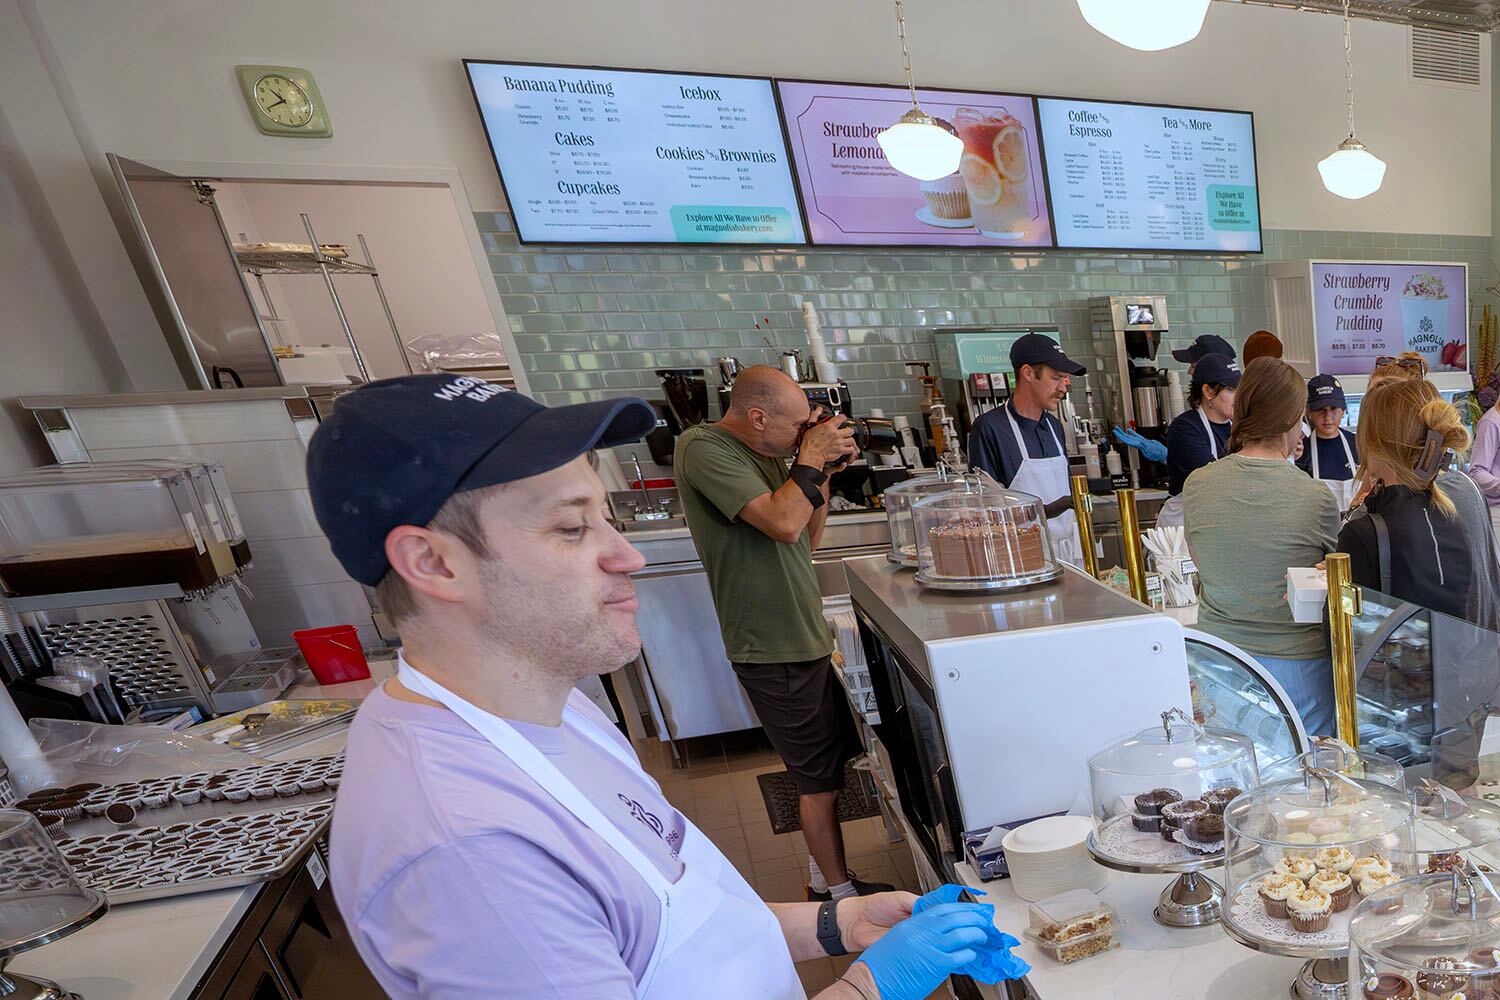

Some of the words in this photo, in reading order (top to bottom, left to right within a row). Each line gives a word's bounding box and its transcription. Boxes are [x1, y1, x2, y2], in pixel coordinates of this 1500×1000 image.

[503, 76, 558, 93] Banana
[558, 79, 615, 98] Pudding
[680, 85, 722, 101] Icebox
[1068, 110, 1098, 124] Coffee
[1162, 116, 1178, 129] Tea
[1189, 119, 1212, 131] More
[1069, 124, 1112, 139] Espresso
[554, 132, 595, 147] Cakes
[656, 145, 705, 161] Cookies
[719, 148, 777, 163] Brownies
[832, 142, 888, 160] Lemona
[557, 180, 621, 197] Cupcakes
[1215, 191, 1237, 199] Explore
[1219, 200, 1228, 208] We
[1228, 200, 1242, 209] Have
[686, 213, 713, 223] Explore
[714, 213, 723, 222] All
[723, 214, 735, 222] We
[735, 214, 752, 223] Have
[759, 214, 778, 223] Offer
[695, 223, 703, 231] at
[1323, 272, 1390, 292] Strawberry
[1334, 294, 1383, 311] Crumble
[1335, 315, 1383, 333] Pudding
[1408, 333, 1445, 348] MAGNOLIA
[1415, 345, 1439, 354] BAKERY
[433, 376, 488, 401] MAGN
[465, 384, 512, 402] BAK
